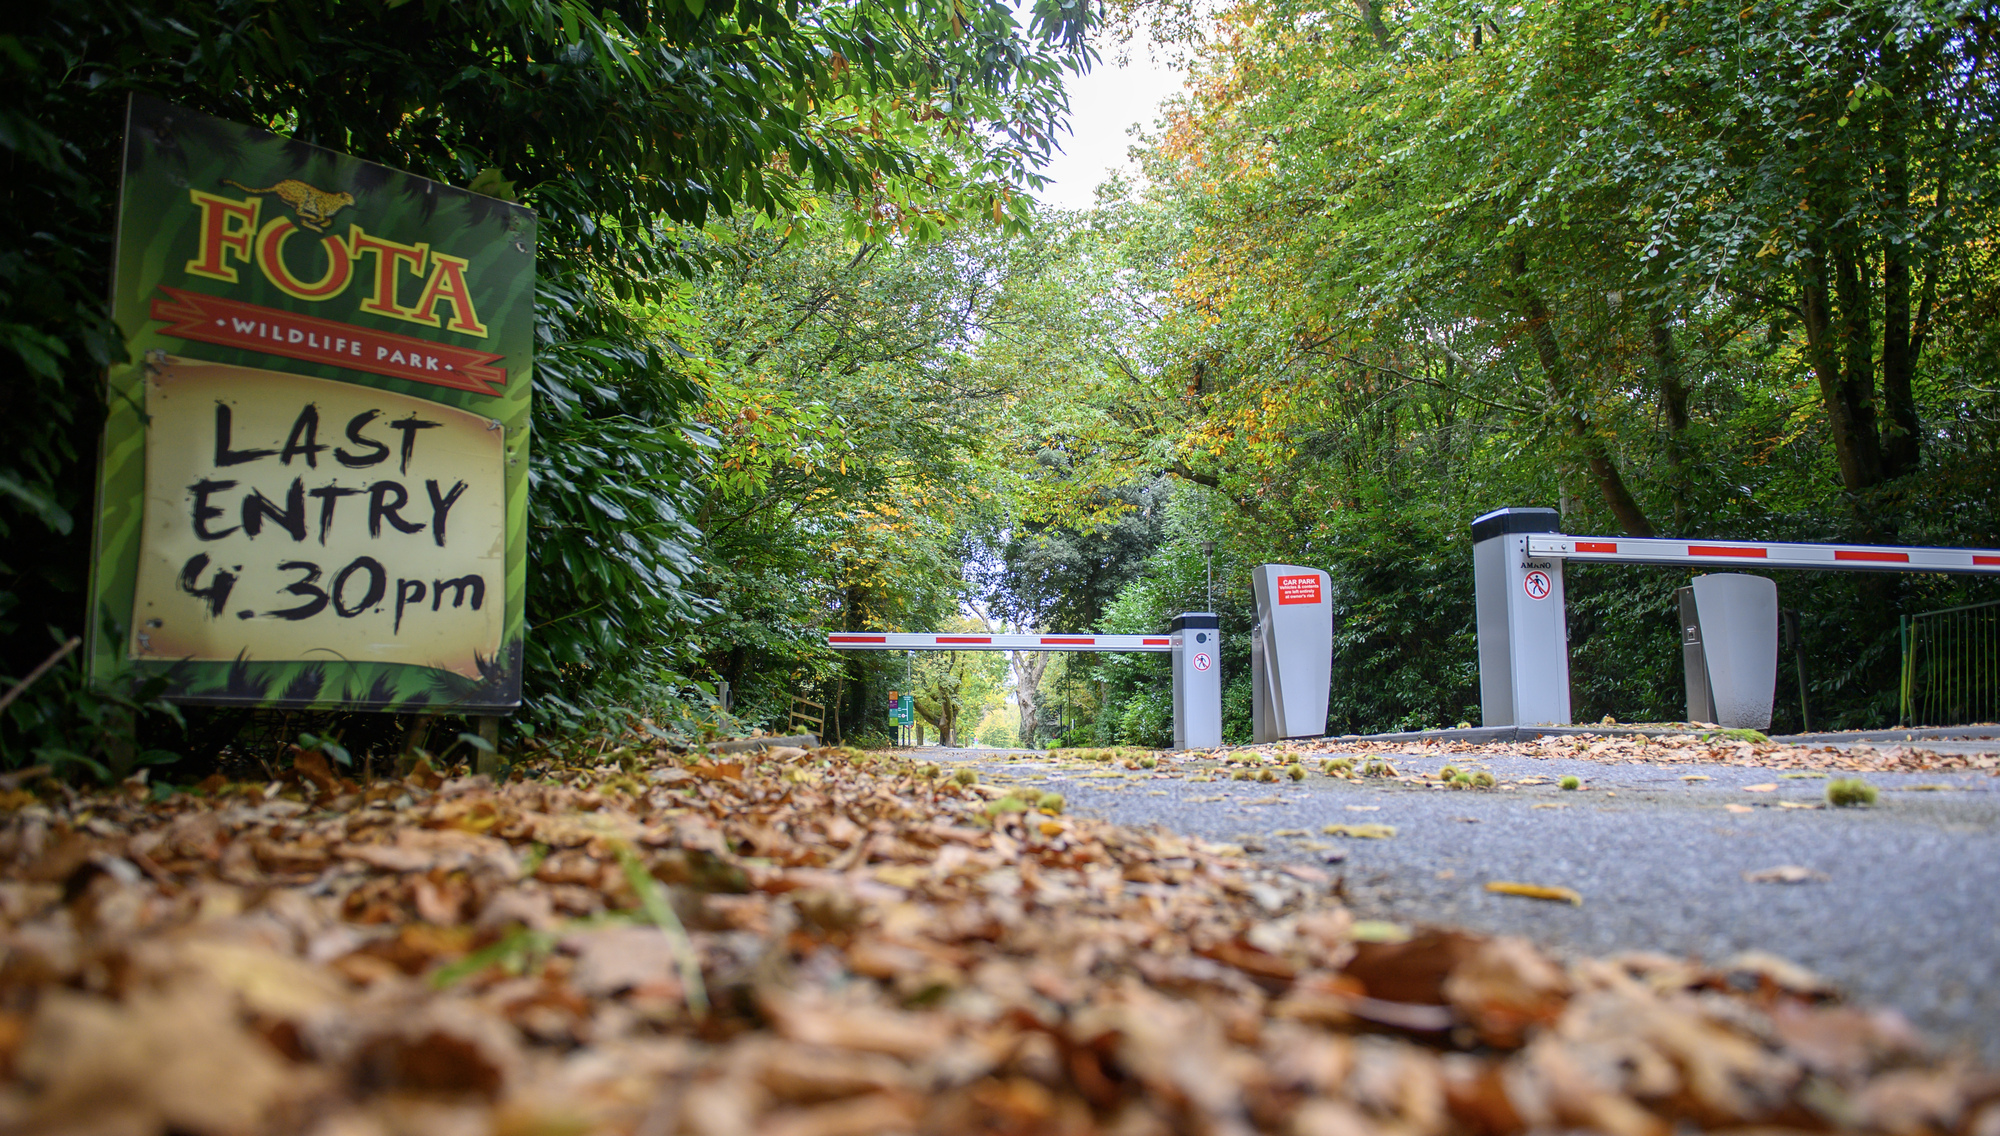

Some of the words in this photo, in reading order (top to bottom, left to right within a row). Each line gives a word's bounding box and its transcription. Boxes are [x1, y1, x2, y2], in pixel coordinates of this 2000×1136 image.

[184, 188, 489, 339] FOTA
[231, 317, 362, 356] WILDLIFE
[376, 346, 439, 371] PARK
[213, 400, 446, 476] LAST
[186, 475, 469, 548] ENTRY
